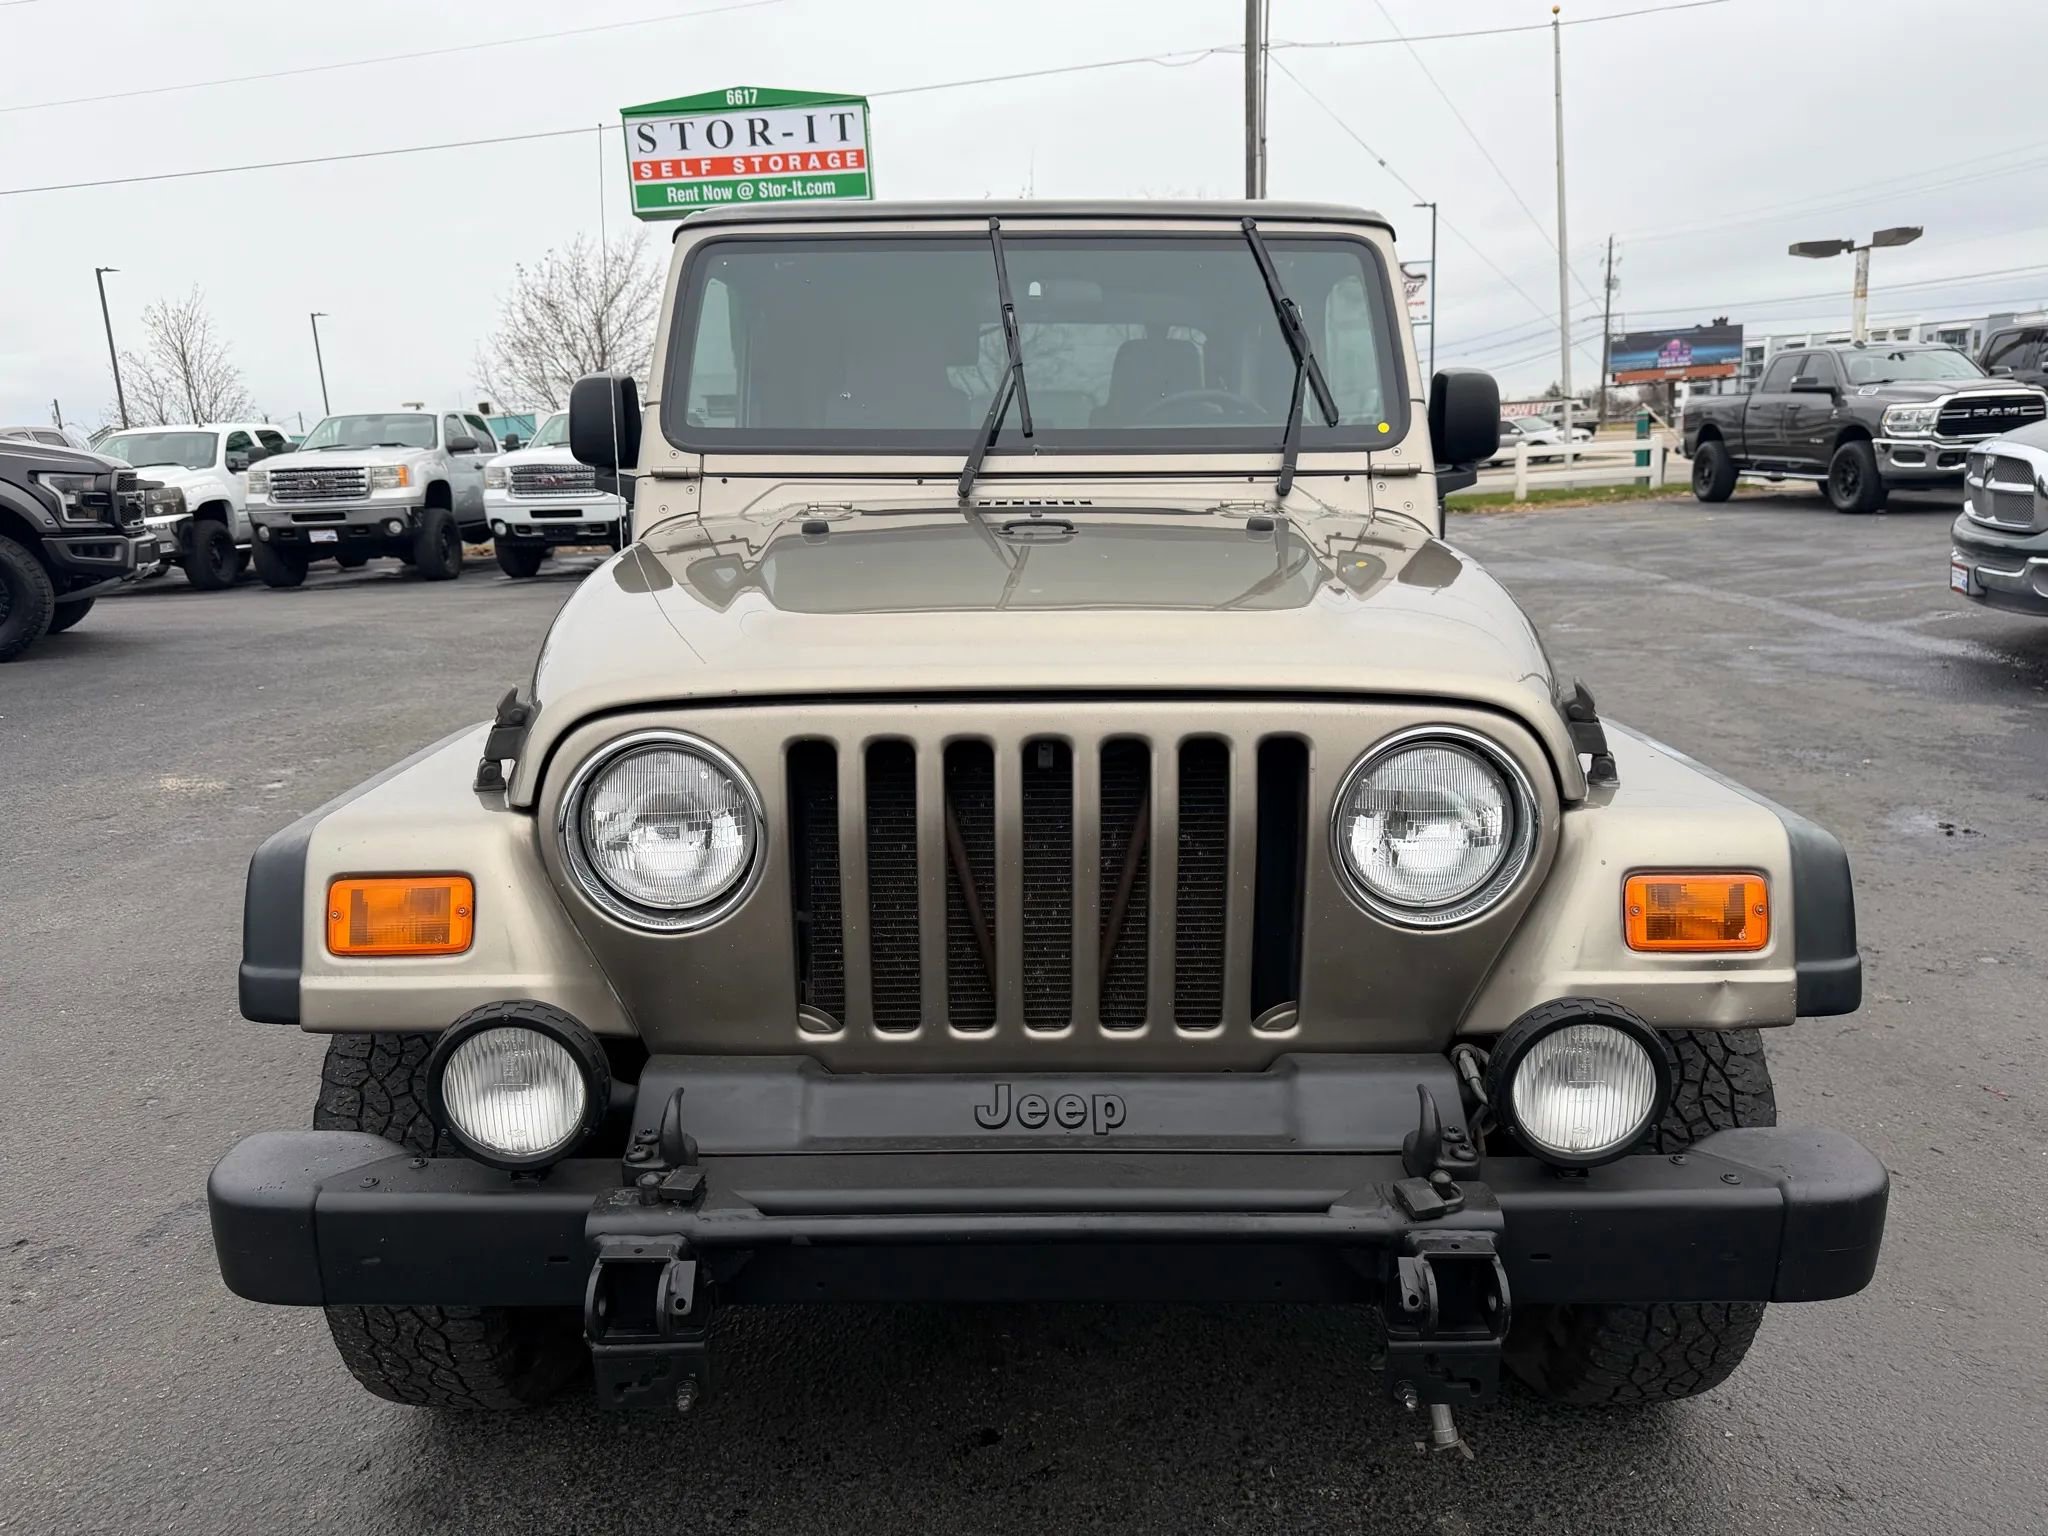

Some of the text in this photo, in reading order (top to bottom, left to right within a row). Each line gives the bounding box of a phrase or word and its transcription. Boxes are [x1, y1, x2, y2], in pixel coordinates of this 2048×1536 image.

[725, 88, 758, 106] 6617
[637, 112, 855, 154] STOR-IT
[640, 151, 859, 179] SELF STORAGE
[666, 179, 836, 203] Rent Now @ Stor-It.com
[1973, 406, 2019, 417] RAM
[974, 1083, 1127, 1136] Jeep
